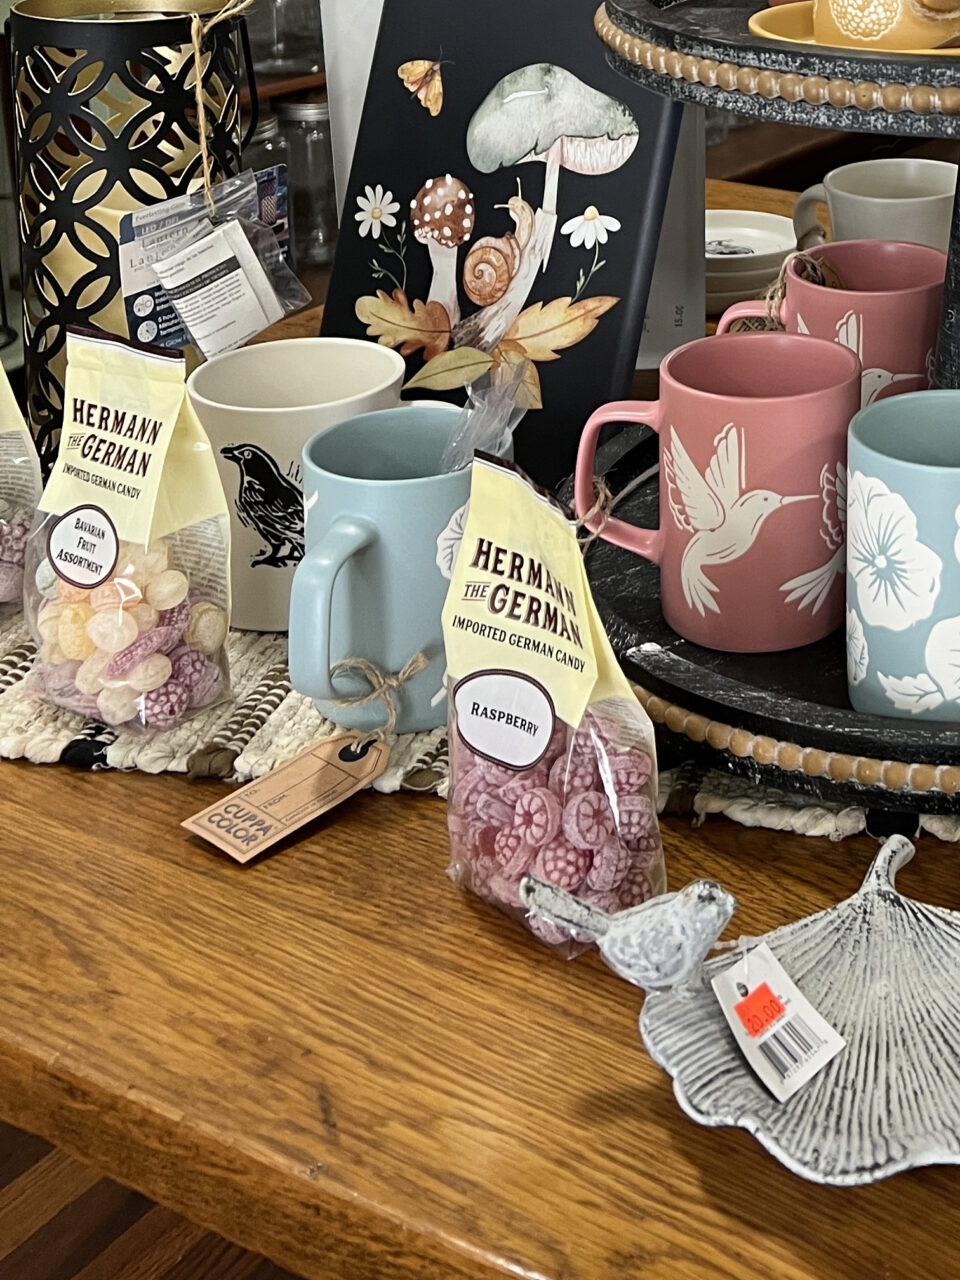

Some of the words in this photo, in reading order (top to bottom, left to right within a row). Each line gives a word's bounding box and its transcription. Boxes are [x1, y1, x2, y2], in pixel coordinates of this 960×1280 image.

[73, 398, 163, 446] HERMANN
[67, 435, 84, 448] THE
[81, 433, 152, 478] GERMAN
[62, 462, 91, 483] IMPORTED
[90, 473, 117, 492] GERMAN
[116, 482, 142, 500] CANDY
[469, 537, 577, 617] HERMANN
[464, 584, 488, 599] THE
[487, 583, 584, 650] GERMAN
[452, 614, 507, 643] IMPORTED
[508, 633, 554, 659] GERMAN
[555, 649, 586, 673] CANDY
[470, 701, 540, 737] RASPBERRY
[207, 813, 259, 847] COLOR
[223, 803, 274, 837] CUPPA
